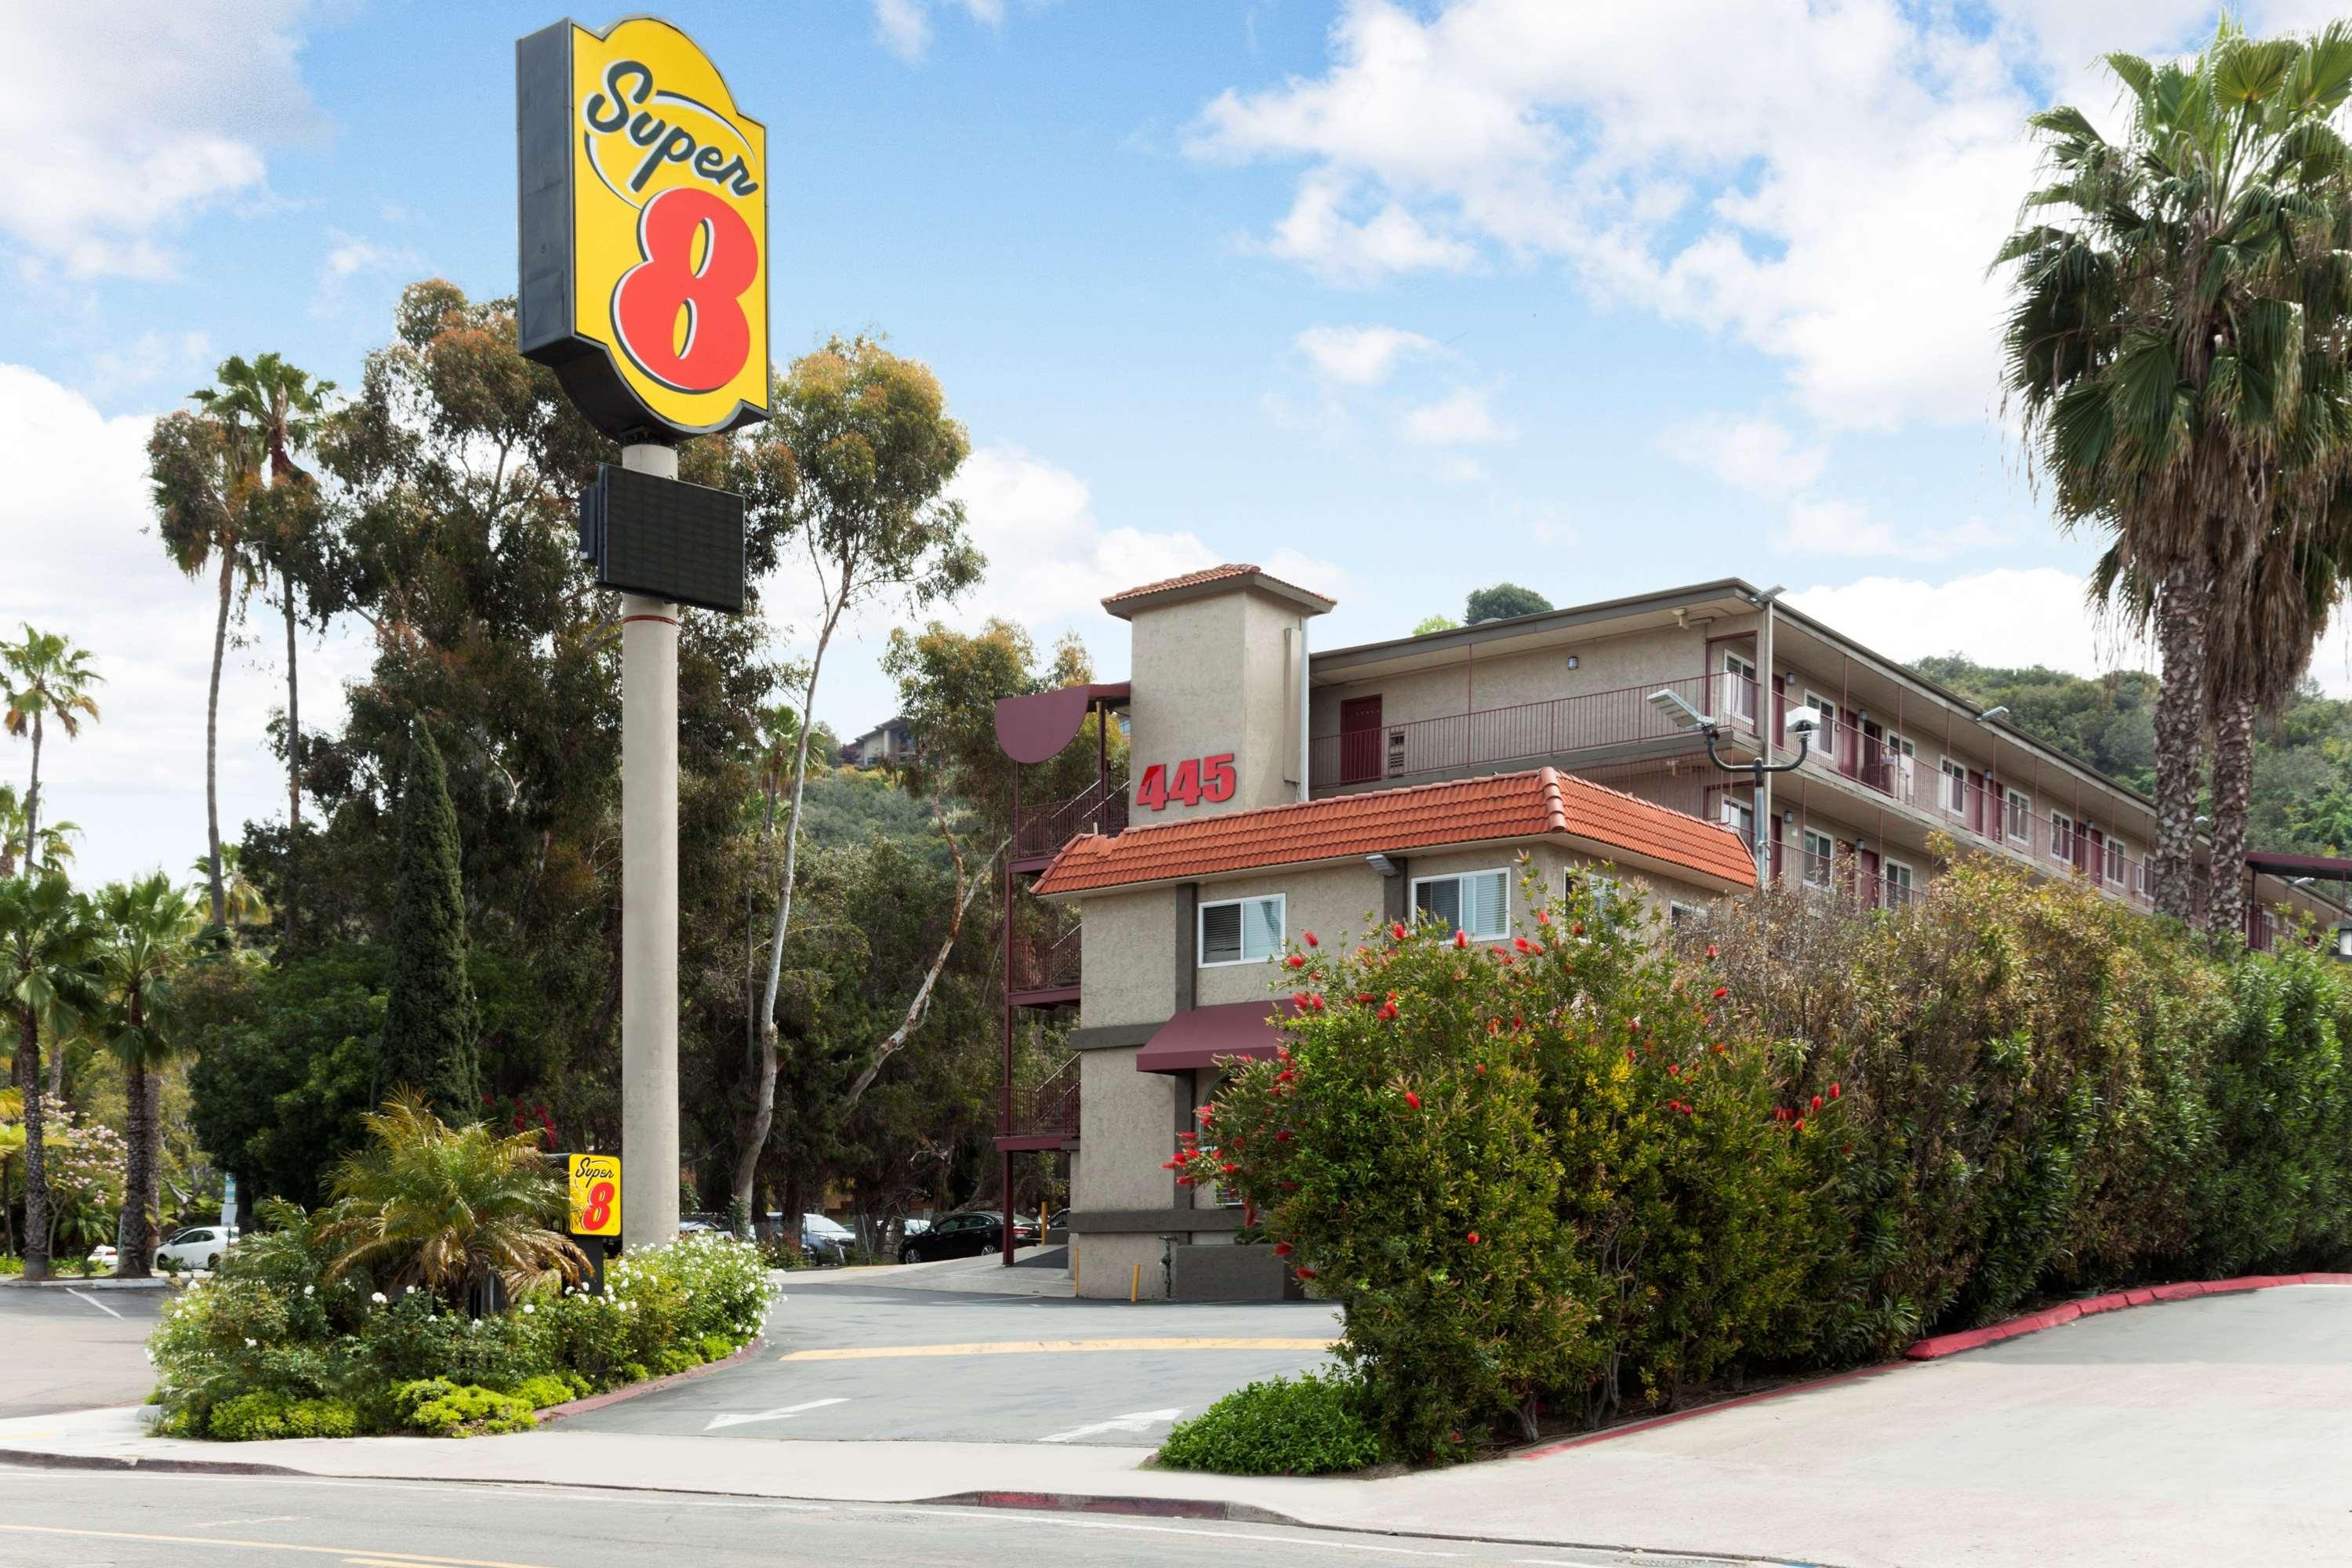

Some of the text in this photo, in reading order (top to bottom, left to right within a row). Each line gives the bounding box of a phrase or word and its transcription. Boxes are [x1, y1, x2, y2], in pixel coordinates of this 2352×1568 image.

[583, 60, 758, 197] Super
[611, 187, 758, 394] 8
[1136, 753, 1236, 811] 445
[575, 1157, 614, 1188] Super
[582, 1182, 615, 1231] 8
